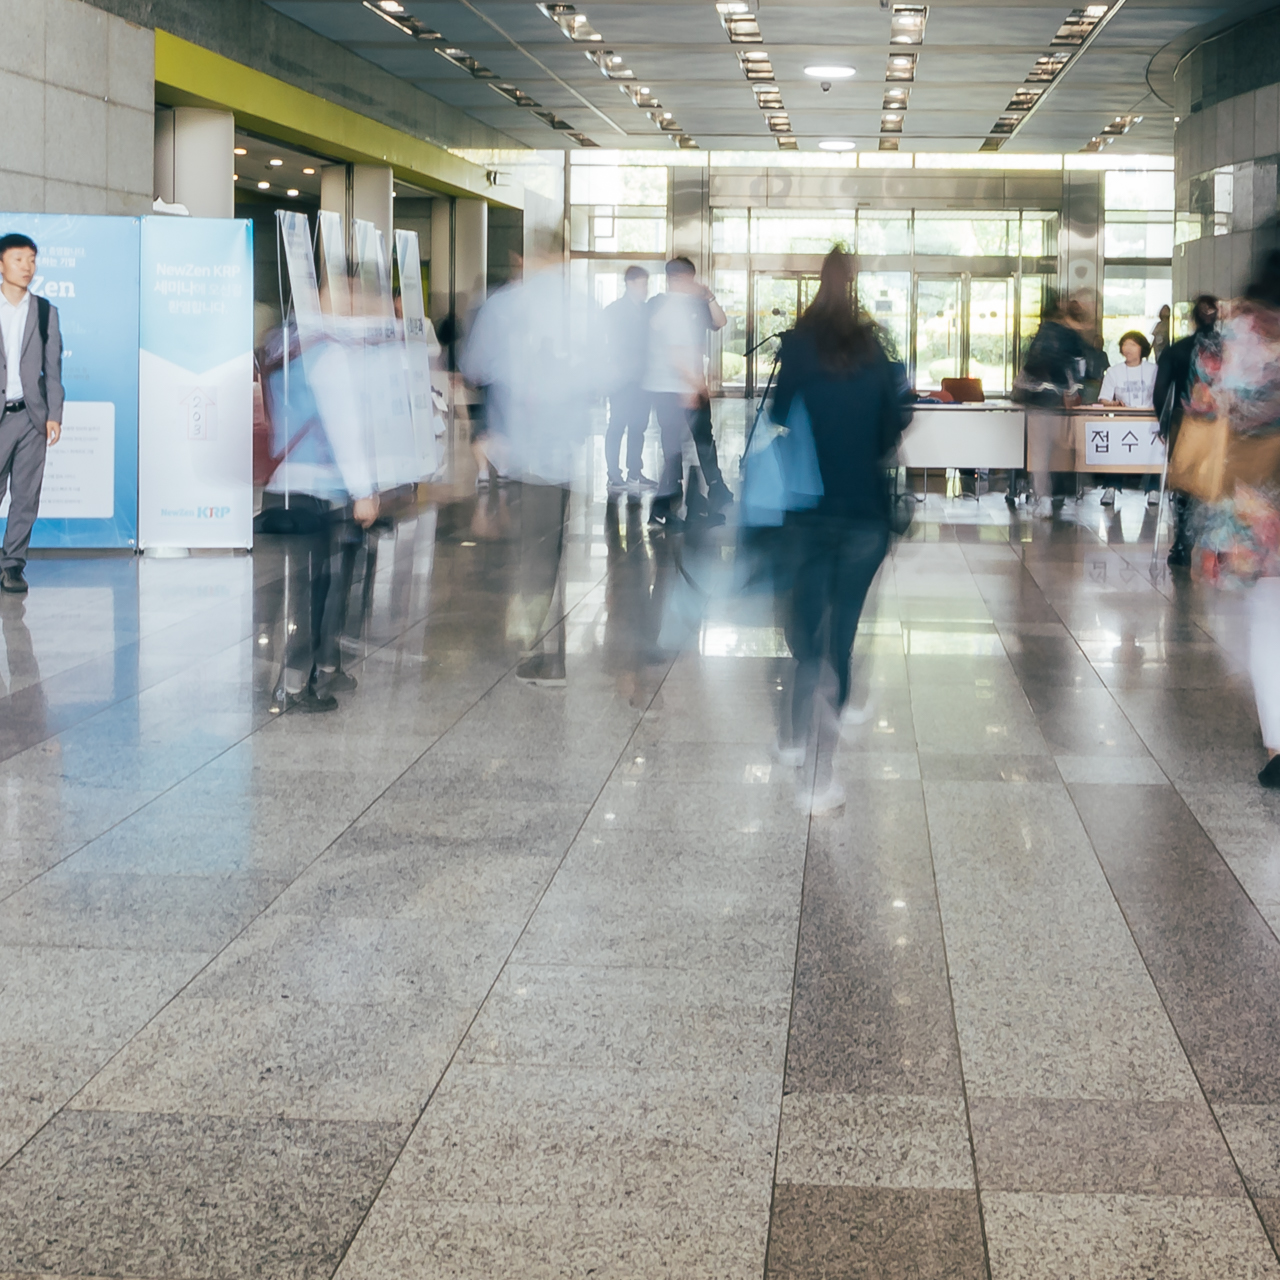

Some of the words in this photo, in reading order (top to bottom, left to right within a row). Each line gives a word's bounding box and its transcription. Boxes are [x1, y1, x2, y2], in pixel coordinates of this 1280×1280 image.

[156, 263, 211, 278] NewZen
[213, 265, 241, 278] KRP
[197, 506, 231, 519] KRP
